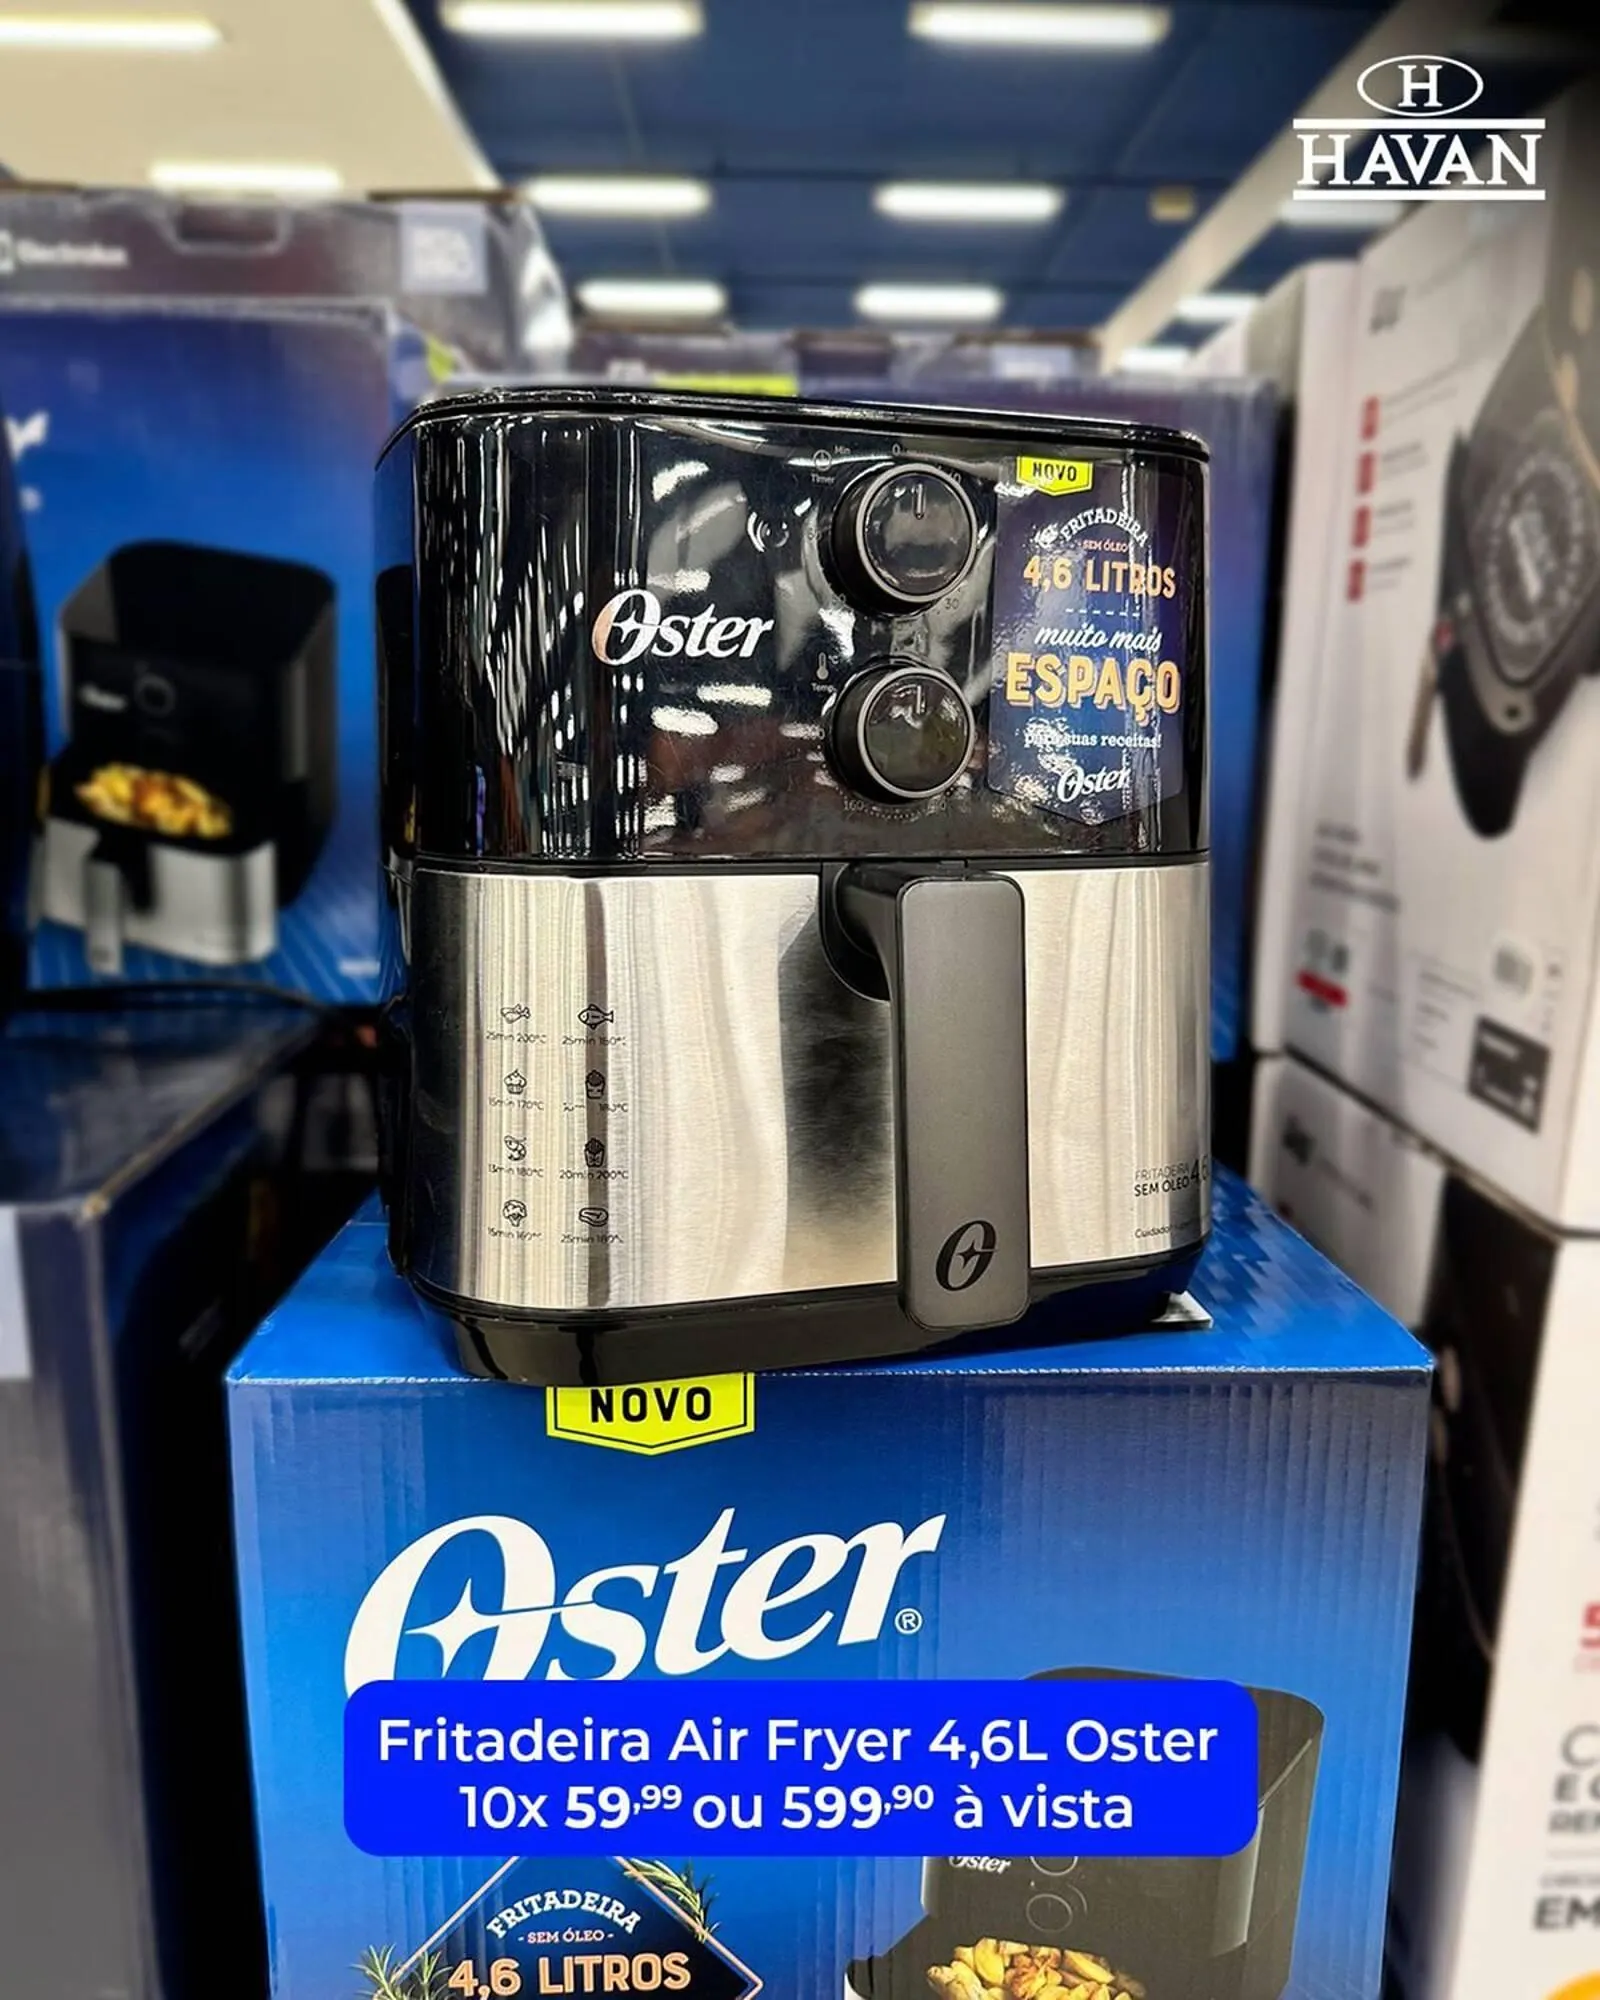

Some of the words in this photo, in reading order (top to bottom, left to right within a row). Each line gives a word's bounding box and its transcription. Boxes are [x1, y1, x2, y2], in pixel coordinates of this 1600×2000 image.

[1032, 461, 1078, 482] NOVO
[1059, 507, 1148, 547] FRITADEIRA
[1023, 555, 1073, 592] 4,6
[1085, 559, 1176, 599] LITROS
[592, 589, 775, 666] Oster
[1034, 622, 1109, 648] muito
[1109, 627, 1163, 653] mais
[1006, 651, 1182, 727] ESPAÇO
[1056, 764, 1131, 803] Oster
[1134, 1182, 1159, 1197] SEM
[590, 1386, 711, 1423] NOVO
[344, 1507, 947, 1700] Oster
[486, 1889, 641, 1939] FRITADEIRA
[527, 1930, 559, 1945] SEM
[563, 1926, 606, 1943] ÓLEO
[447, 1958, 522, 2000] 4,6
[538, 1952, 692, 1994] LITROS
